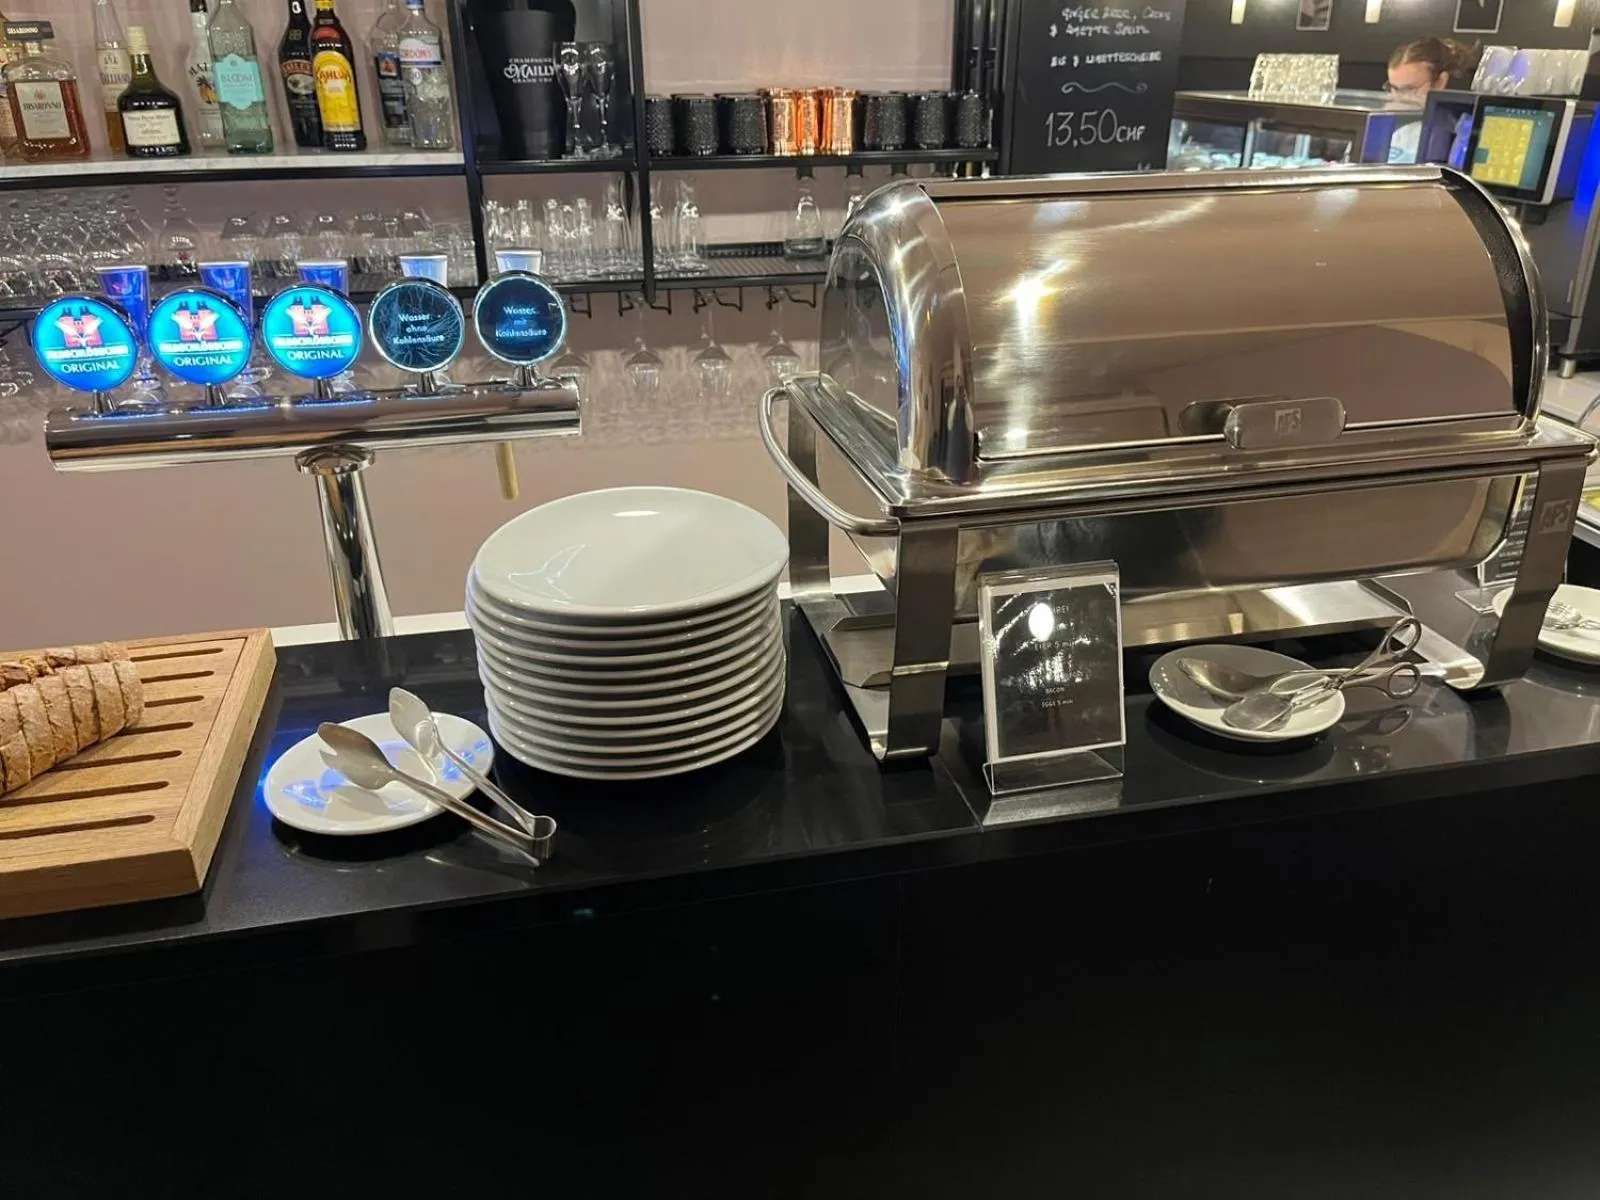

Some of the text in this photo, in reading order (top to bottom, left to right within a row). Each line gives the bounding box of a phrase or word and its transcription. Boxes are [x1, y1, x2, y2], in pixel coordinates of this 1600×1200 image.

[173, 354, 233, 367] ORIGINAL
[287, 349, 345, 361] ORIGINAL
[61, 359, 121, 374] ORIGINAL
